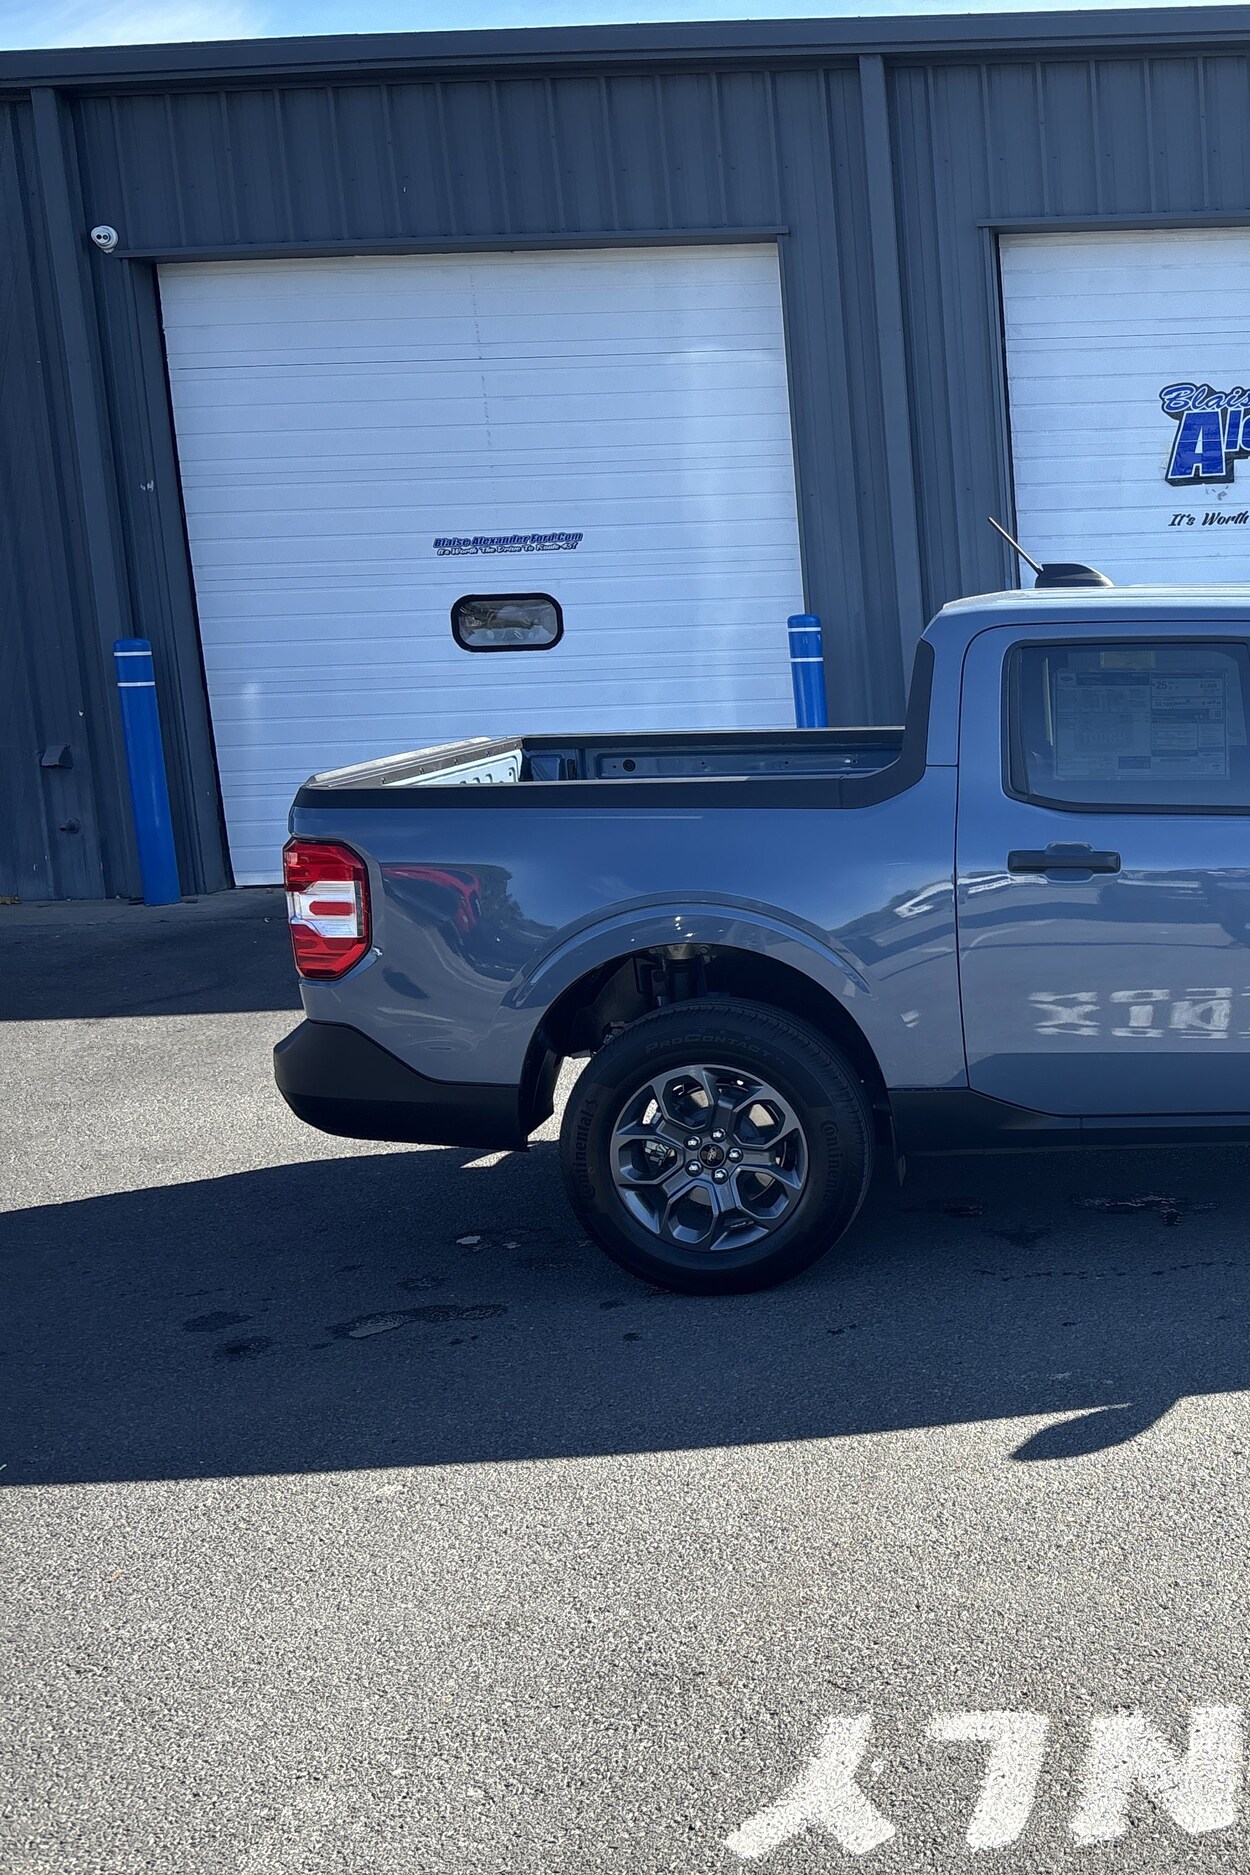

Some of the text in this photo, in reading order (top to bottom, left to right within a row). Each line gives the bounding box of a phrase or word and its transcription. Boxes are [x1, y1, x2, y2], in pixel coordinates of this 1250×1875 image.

[1168, 512, 1196, 527] It's
[1201, 510, 1250, 527] Worth
[433, 537, 471, 548] Blaise
[471, 535, 531, 546] Alexander
